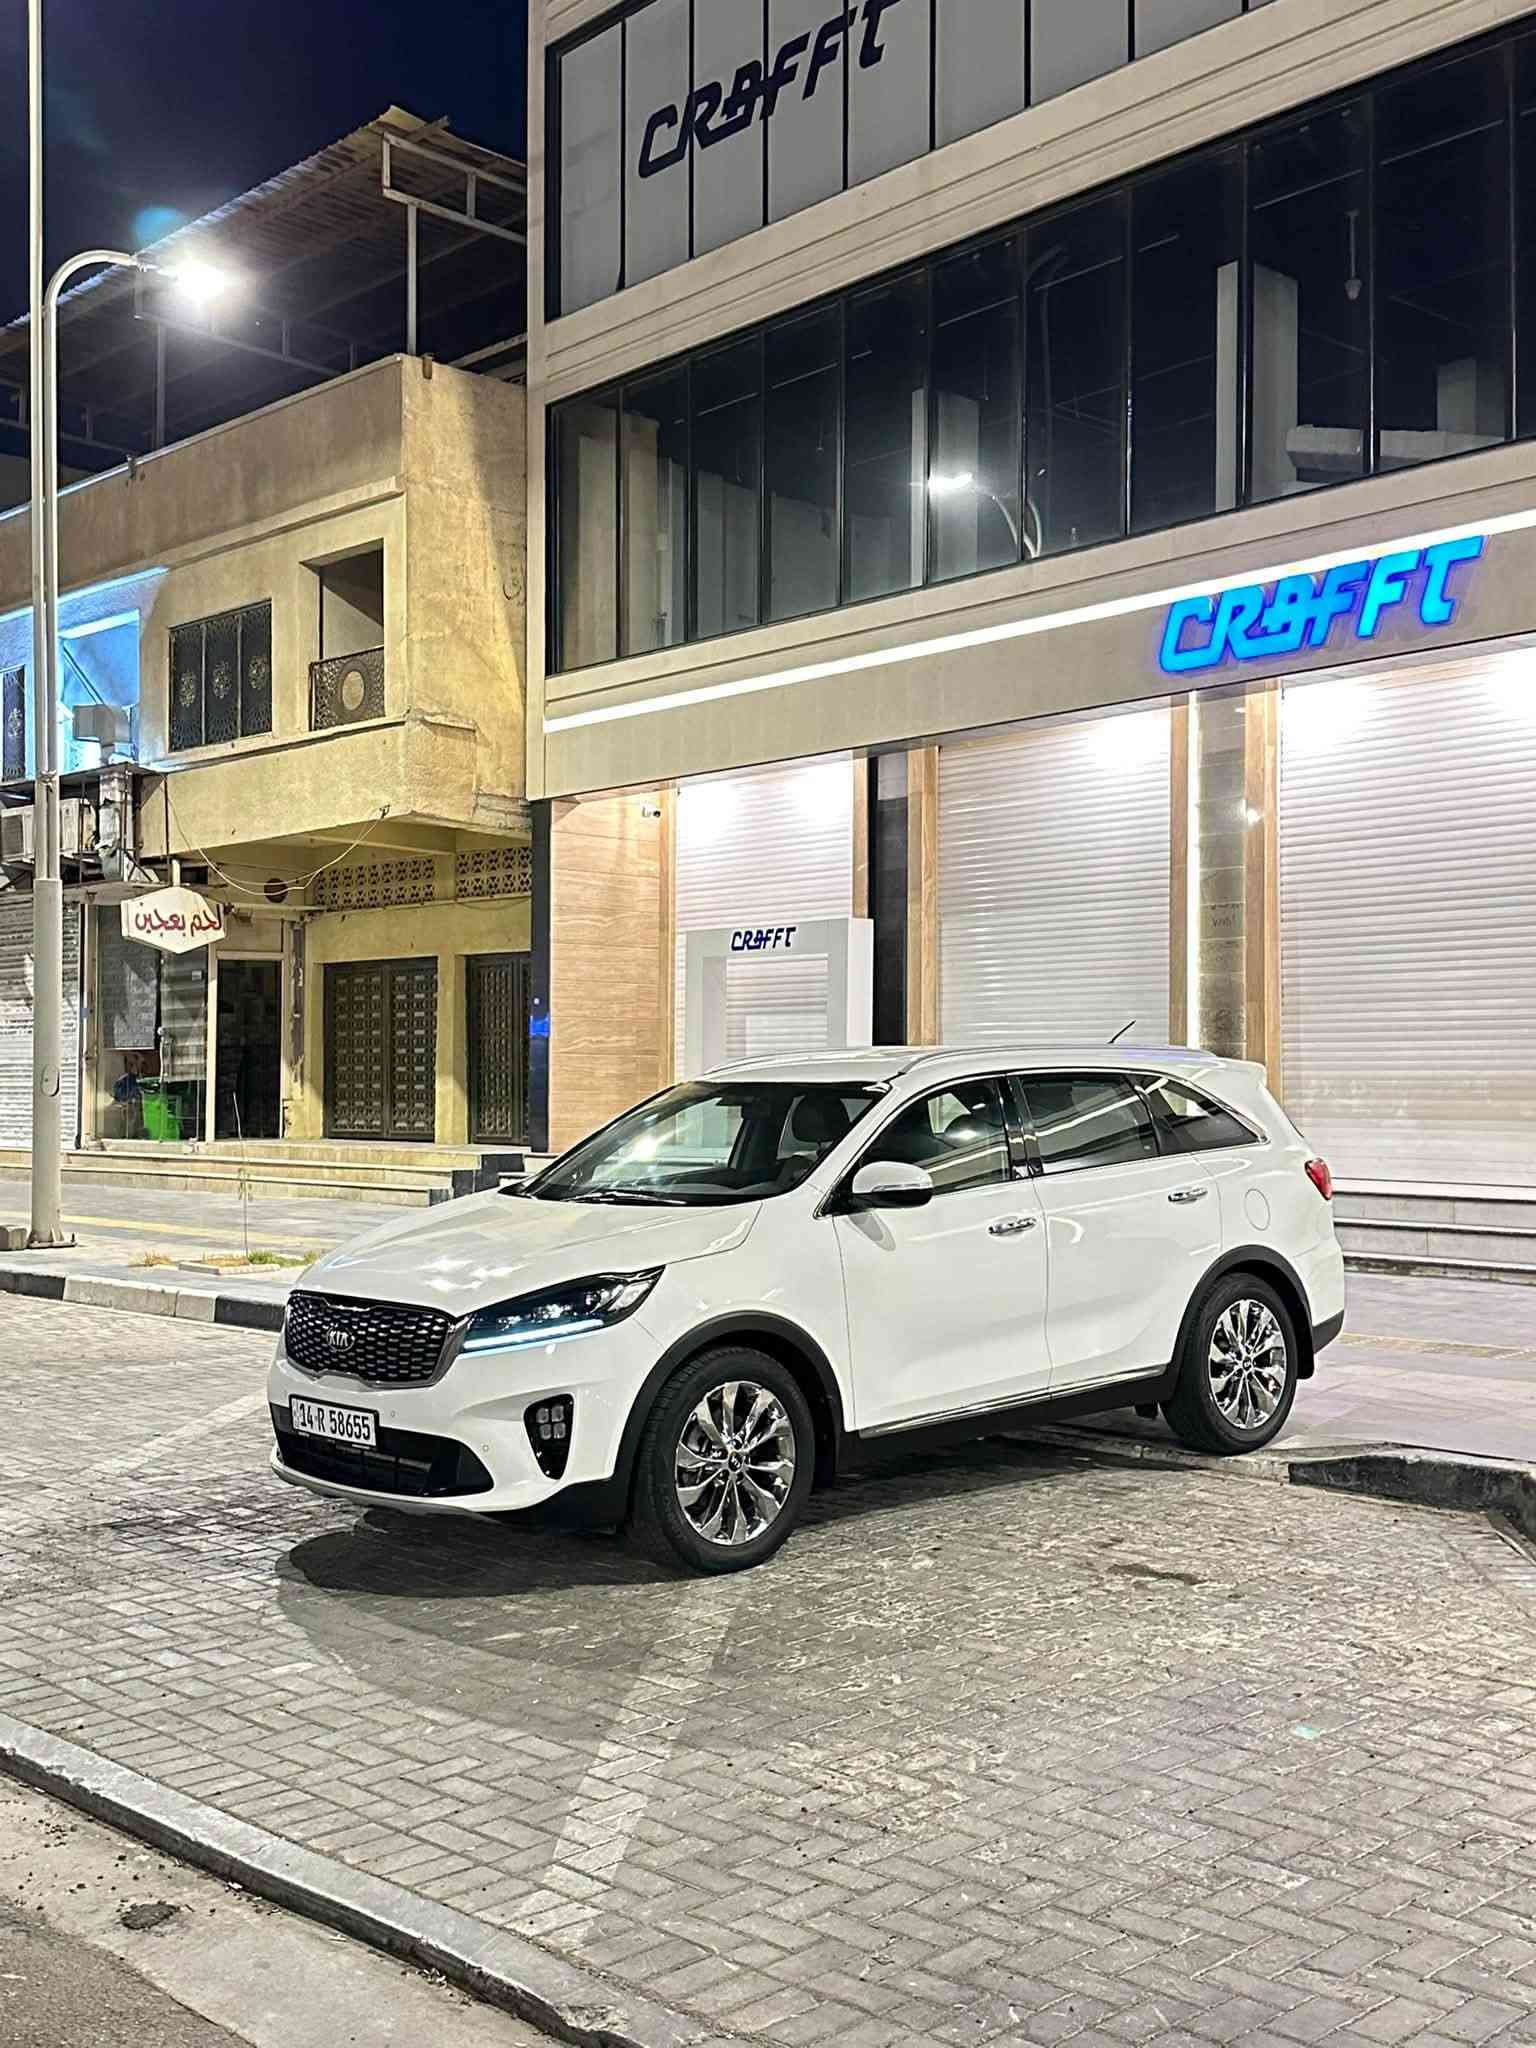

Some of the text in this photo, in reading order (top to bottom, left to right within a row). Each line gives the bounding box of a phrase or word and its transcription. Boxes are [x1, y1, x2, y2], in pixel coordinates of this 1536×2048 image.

[1159, 535, 1486, 673] CRAFFT
[135, 901, 222, 937] لحم بعجين
[731, 926, 797, 952] CRAFFT
[329, 1330, 349, 1347] KIA
[329, 1409, 370, 1441] 58655
